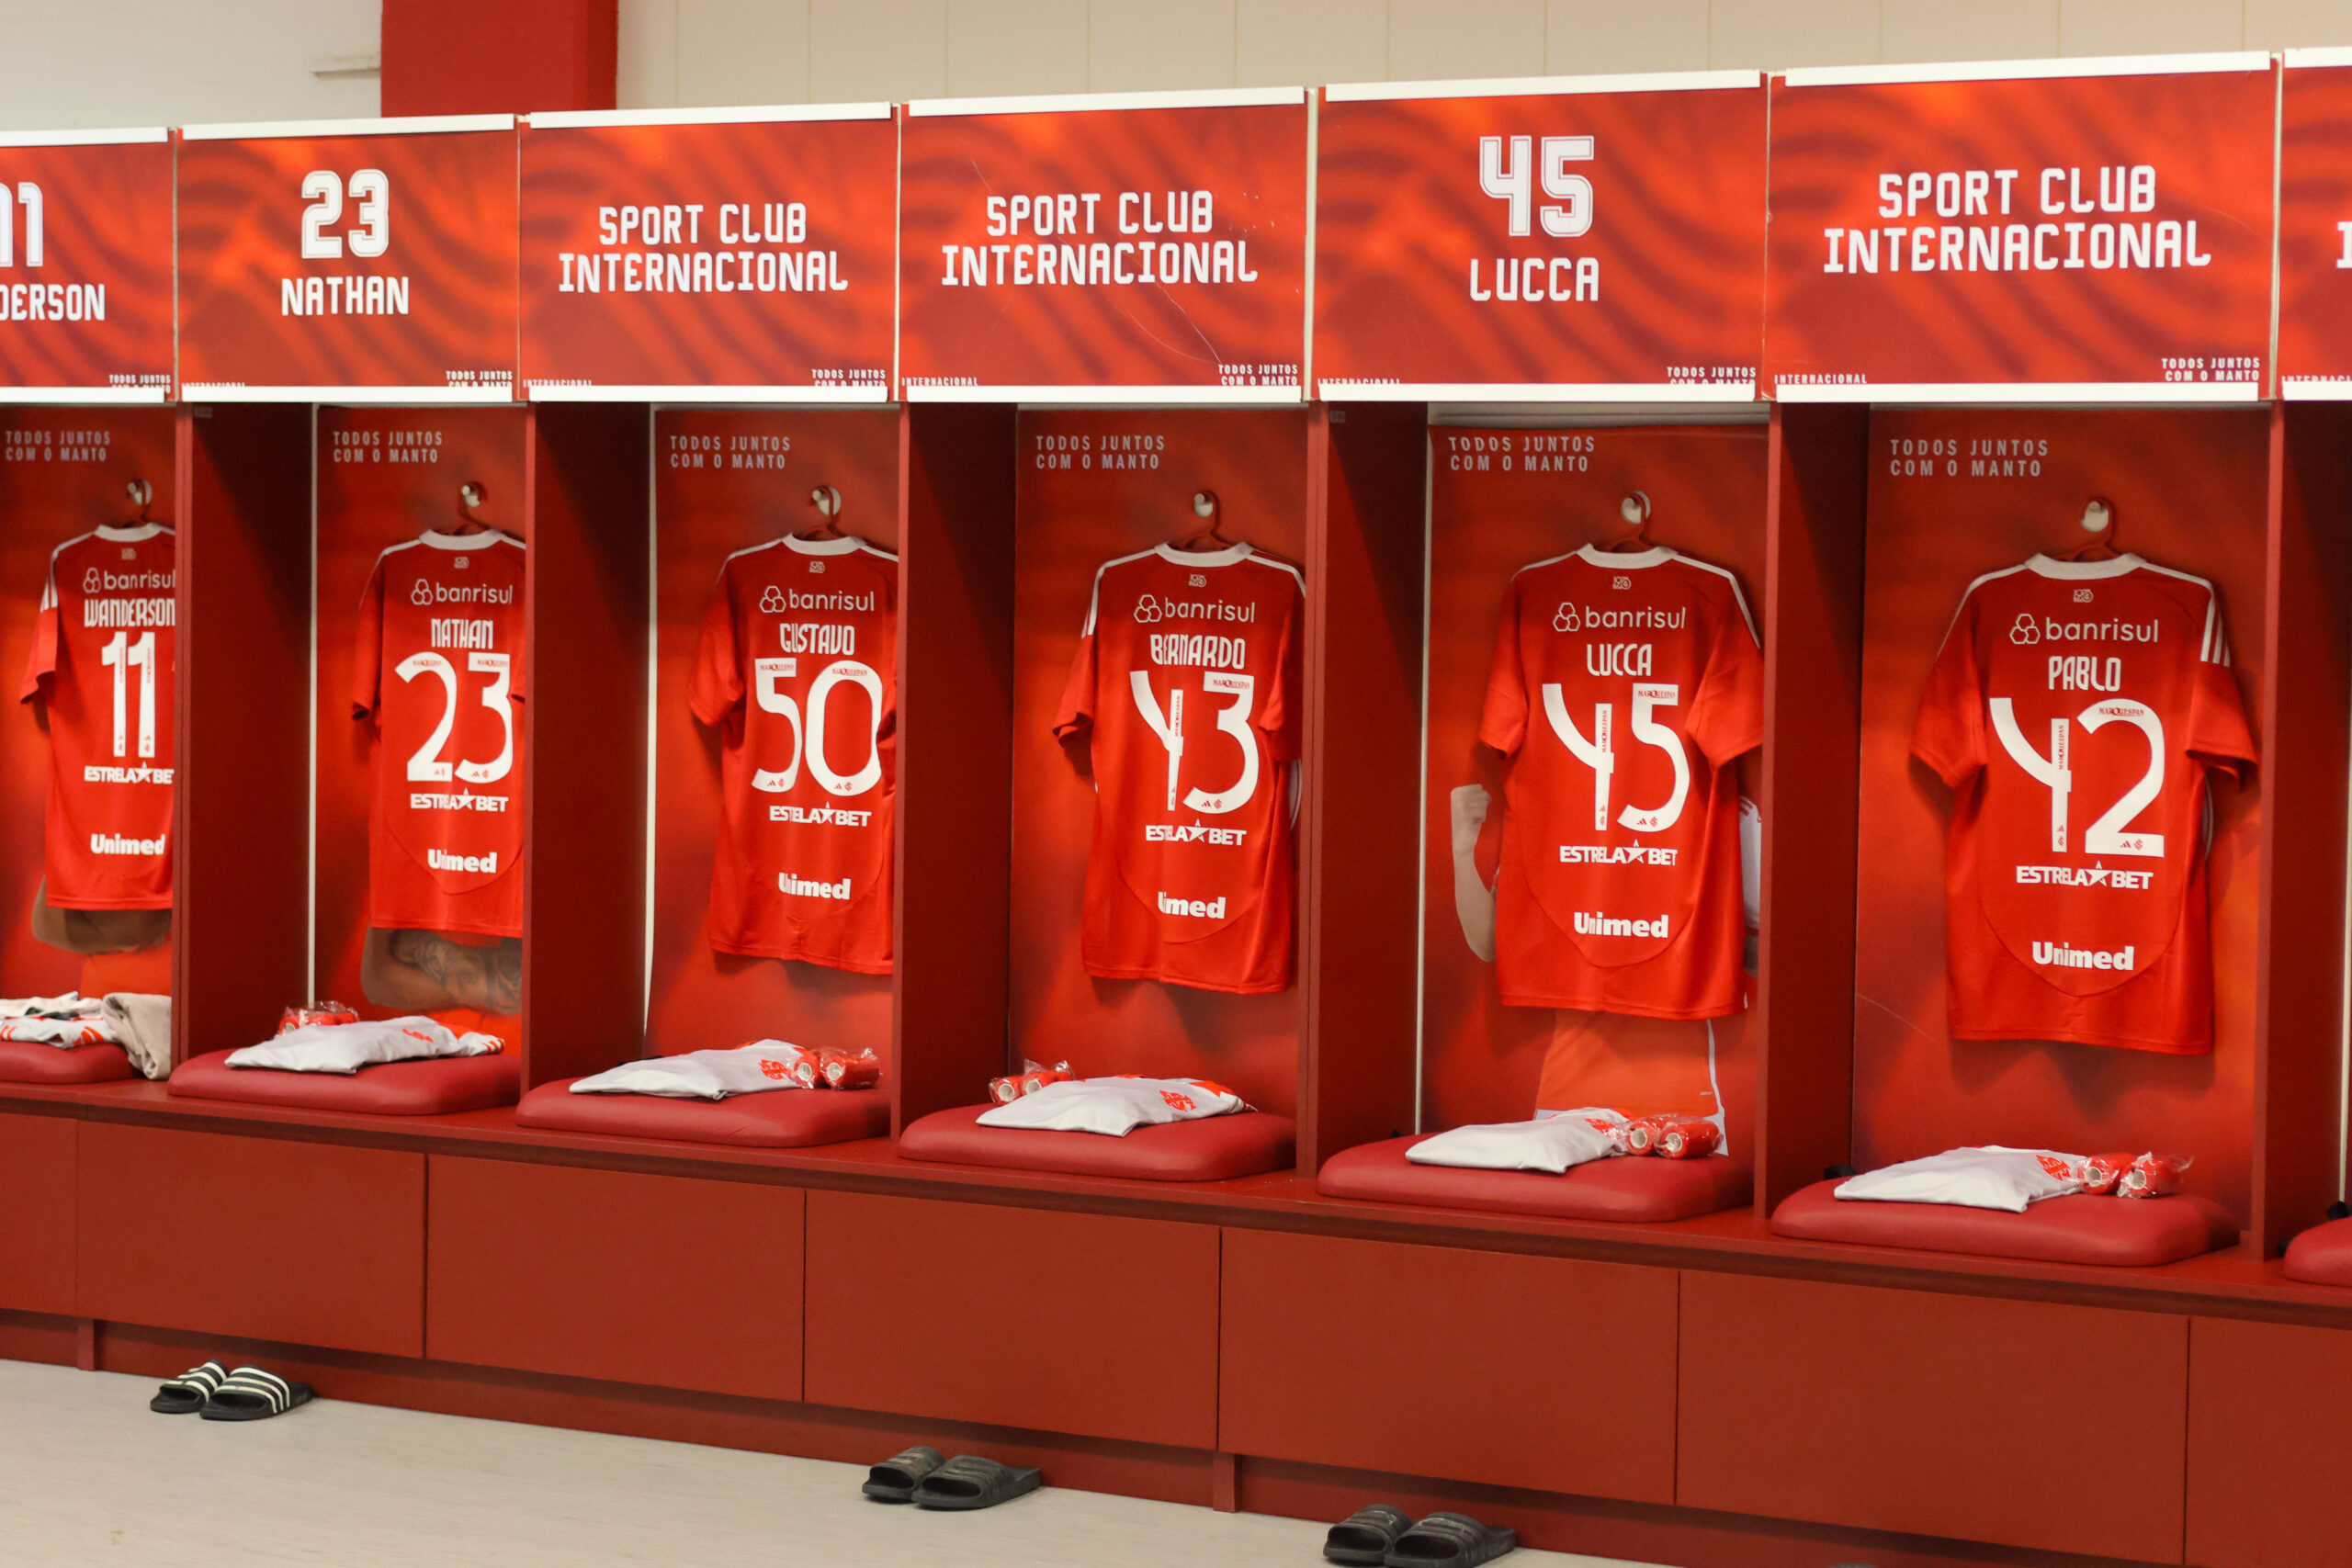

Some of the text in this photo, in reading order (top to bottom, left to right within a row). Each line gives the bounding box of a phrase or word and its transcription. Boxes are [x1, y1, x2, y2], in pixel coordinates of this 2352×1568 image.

[1479, 135, 1594, 237] 45
[1879, 164, 2156, 218] SPORT CLUB
[301, 168, 390, 259] 23
[599, 202, 807, 245] SPORT CLUB
[987, 190, 1213, 236] SPORT CLUB
[1823, 220, 2211, 274] INTERNACIONAL
[559, 250, 849, 293] INTERNACIONAL
[941, 240, 1259, 287] INTERNACIONAL
[1470, 257, 1600, 302] LUCCA
[281, 276, 409, 316] NATHAN
[811, 369, 886, 379] TODOS JUNTOS
[1218, 364, 1298, 375] TODOS JUNTOS
[1667, 367, 1757, 378] TODOS JUNTOS
[2161, 357, 2260, 369] TODOS JUNTOS
[2165, 369, 2260, 381] COM O MANTO
[108, 374, 171, 384] TODOS JUNTOS
[446, 371, 513, 380] TODOS JUNTOS
[901, 377, 978, 387] INTERNACIONAL
[1221, 376, 1297, 386] COM O MANTO
[1774, 374, 1868, 384] INTERNACIONAL
[6, 430, 111, 446] TODOS JUNTOS
[333, 431, 443, 446] TODOS JUNTOS
[670, 435, 791, 452] TODOS JUNTOS
[1035, 434, 1165, 451] TODOS JUNTOS
[1448, 435, 1595, 453] TODOS JUNTOS
[1890, 438, 2048, 457] TODOS JUNTOS
[6, 446, 107, 461] COM O MANTO
[334, 447, 438, 463] COM O MANTO
[670, 453, 786, 469] COM O MANTO
[1035, 454, 1159, 469] COM O MANTO
[1450, 454, 1589, 472] COM O MANTO
[1890, 459, 2041, 477] COM O MANTO
[104, 570, 175, 590] banrisul
[436, 581, 513, 604] banrisul
[789, 589, 875, 613] banrisul
[84, 598, 175, 628] WANDERSON
[1165, 597, 1255, 623] banrisul
[1585, 606, 1686, 629] banrisul
[431, 618, 493, 649] NATHAN
[779, 623, 855, 656] GUSTAVO
[2046, 617, 2158, 643] banrisul
[1150, 634, 1245, 670] BERNARDO
[1587, 644, 1652, 676] LUCCA
[2048, 655, 2121, 692] PABLO
[101, 631, 155, 758] 11
[395, 651, 514, 784] 23
[752, 658, 883, 796] 50
[1130, 671, 1259, 814] 43
[1542, 683, 1690, 832] 45
[1989, 697, 2165, 858] 42
[90, 833, 165, 854] Unimed
[1574, 911, 1668, 939] Unimed
[2032, 942, 2134, 971] Unimed
